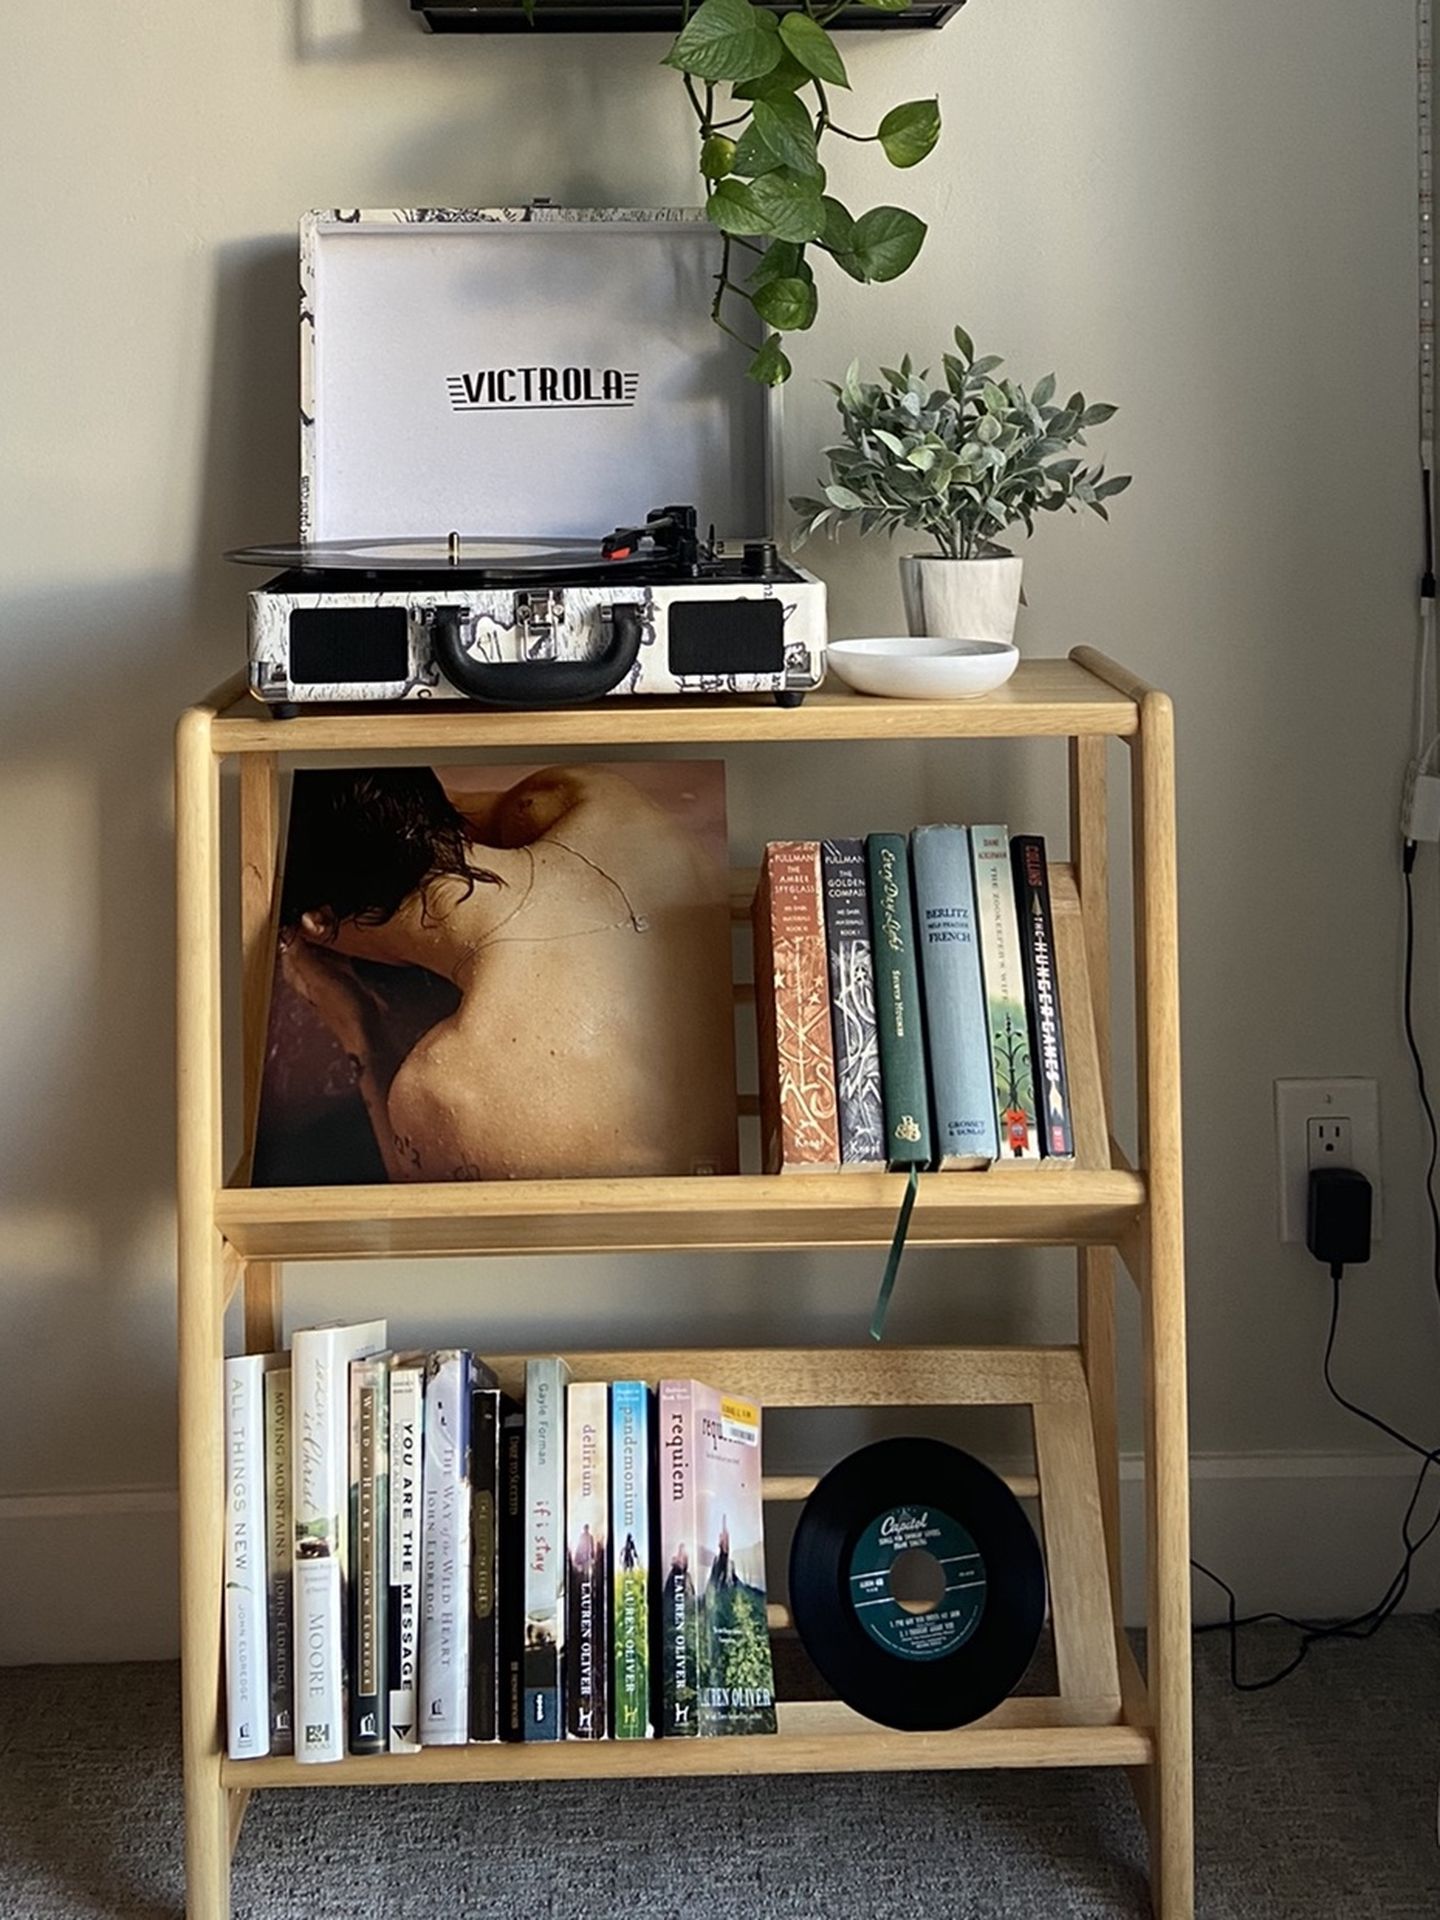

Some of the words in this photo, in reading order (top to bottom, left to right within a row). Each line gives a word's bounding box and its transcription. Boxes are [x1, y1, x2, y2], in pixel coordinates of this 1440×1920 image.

[462, 367, 623, 404] VICTROLA
[774, 853, 815, 863] PULLMAN
[779, 875, 810, 884] AMBER
[787, 865, 800, 873] THE
[825, 855, 865, 865] PULLMAN
[839, 869, 853, 878] THE
[774, 885, 815, 894] SPYGLASS
[827, 878, 866, 888] GOLDEN
[828, 888, 866, 898] COMPASS
[925, 907, 969, 920] BERLITZ
[928, 931, 971, 944] FRENCH
[1034, 942, 1054, 1017] HUNGER
[1041, 1021, 1060, 1082] GAMES
[232, 1379, 245, 1418] ALL
[538, 1383, 550, 1416] Gayle
[273, 1391, 286, 1456] MOVING
[362, 1395, 372, 1447] WILD
[402, 1423, 413, 1466] YOU
[443, 1448, 454, 1476] THE
[538, 1421, 549, 1465] Forman
[582, 1424, 597, 1497] delirium
[665, 1413, 689, 1501] requiem
[233, 1427, 247, 1512] THINGS
[619, 1406, 638, 1527] pandemonium
[274, 1462, 287, 1558] MOUNTAINS
[362, 1477, 372, 1543] HEART
[402, 1478, 413, 1520] ARE
[427, 1489, 438, 1532] JOHN
[443, 1484, 454, 1522] WAY
[533, 1500, 551, 1517] if
[881, 1512, 929, 1536] Capitol
[235, 1522, 248, 1570] NEW
[402, 1531, 413, 1572] THE
[530, 1536, 552, 1572] stay
[276, 1579, 287, 1616] JOHN
[363, 1570, 372, 1605] JOHN
[426, 1540, 437, 1623] ELDREDGE
[442, 1559, 454, 1604] WILD
[673, 1574, 685, 1631] LAUREN
[237, 1605, 246, 1637] JOHN
[580, 1582, 592, 1639] LAUREN
[624, 1580, 635, 1636] LAUREN
[276, 1623, 288, 1690] ELDREDGE
[308, 1613, 326, 1698] MOORE
[362, 1613, 372, 1685] ELDREDGE
[402, 1584, 413, 1692] MESSAGE
[441, 1612, 454, 1667] HEART
[238, 1642, 249, 1702] ELDREDGE
[580, 1643, 592, 1696] OLIVER
[625, 1640, 636, 1693] OLIVER
[674, 1635, 687, 1689] OLIVER
[731, 1687, 772, 1708] OLIVER
[305, 1723, 330, 1743] B&H
